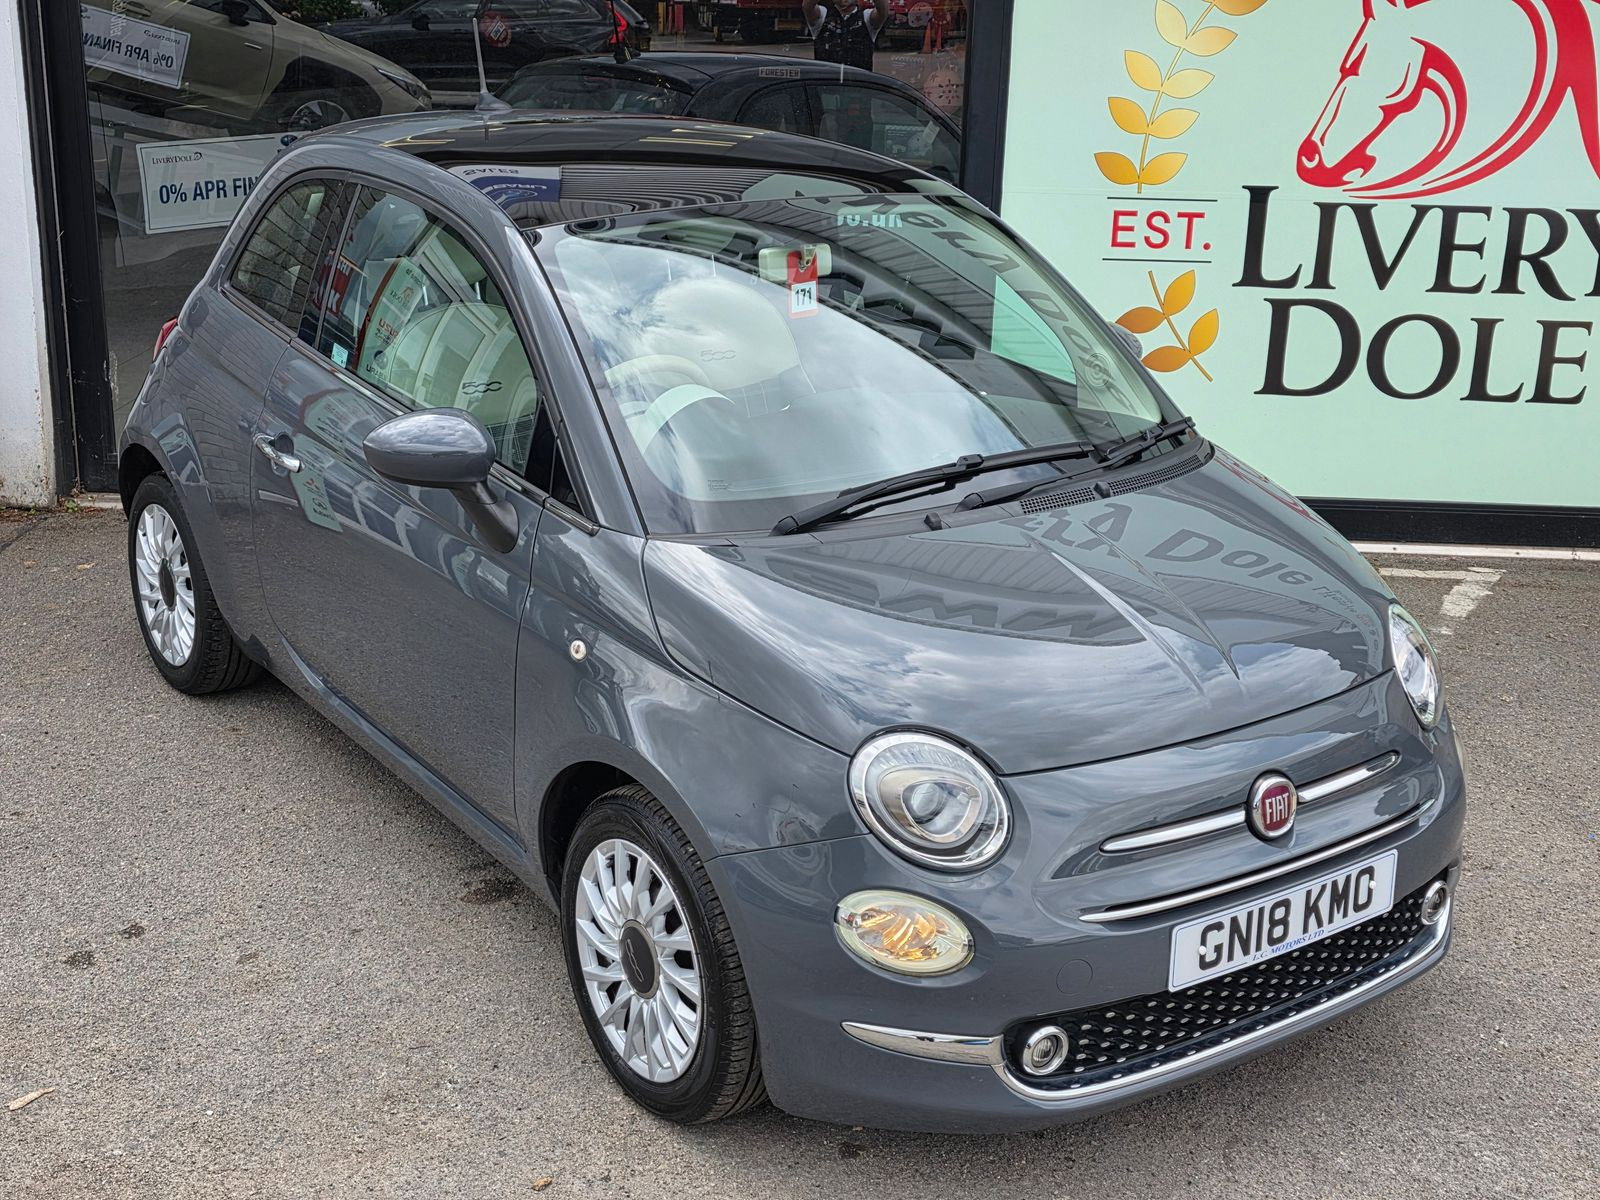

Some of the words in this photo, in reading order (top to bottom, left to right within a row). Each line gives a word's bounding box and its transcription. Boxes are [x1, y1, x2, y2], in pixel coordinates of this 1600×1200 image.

[159, 183, 187, 204] 0%
[193, 180, 227, 201] APR
[1110, 209, 1212, 250] EST.
[795, 287, 812, 307] 171
[1254, 297, 1593, 405] DOLE
[462, 381, 503, 395] 500
[1265, 793, 1290, 825] FIAT
[1198, 897, 1292, 971] GN18
[1302, 865, 1376, 935] KMO
